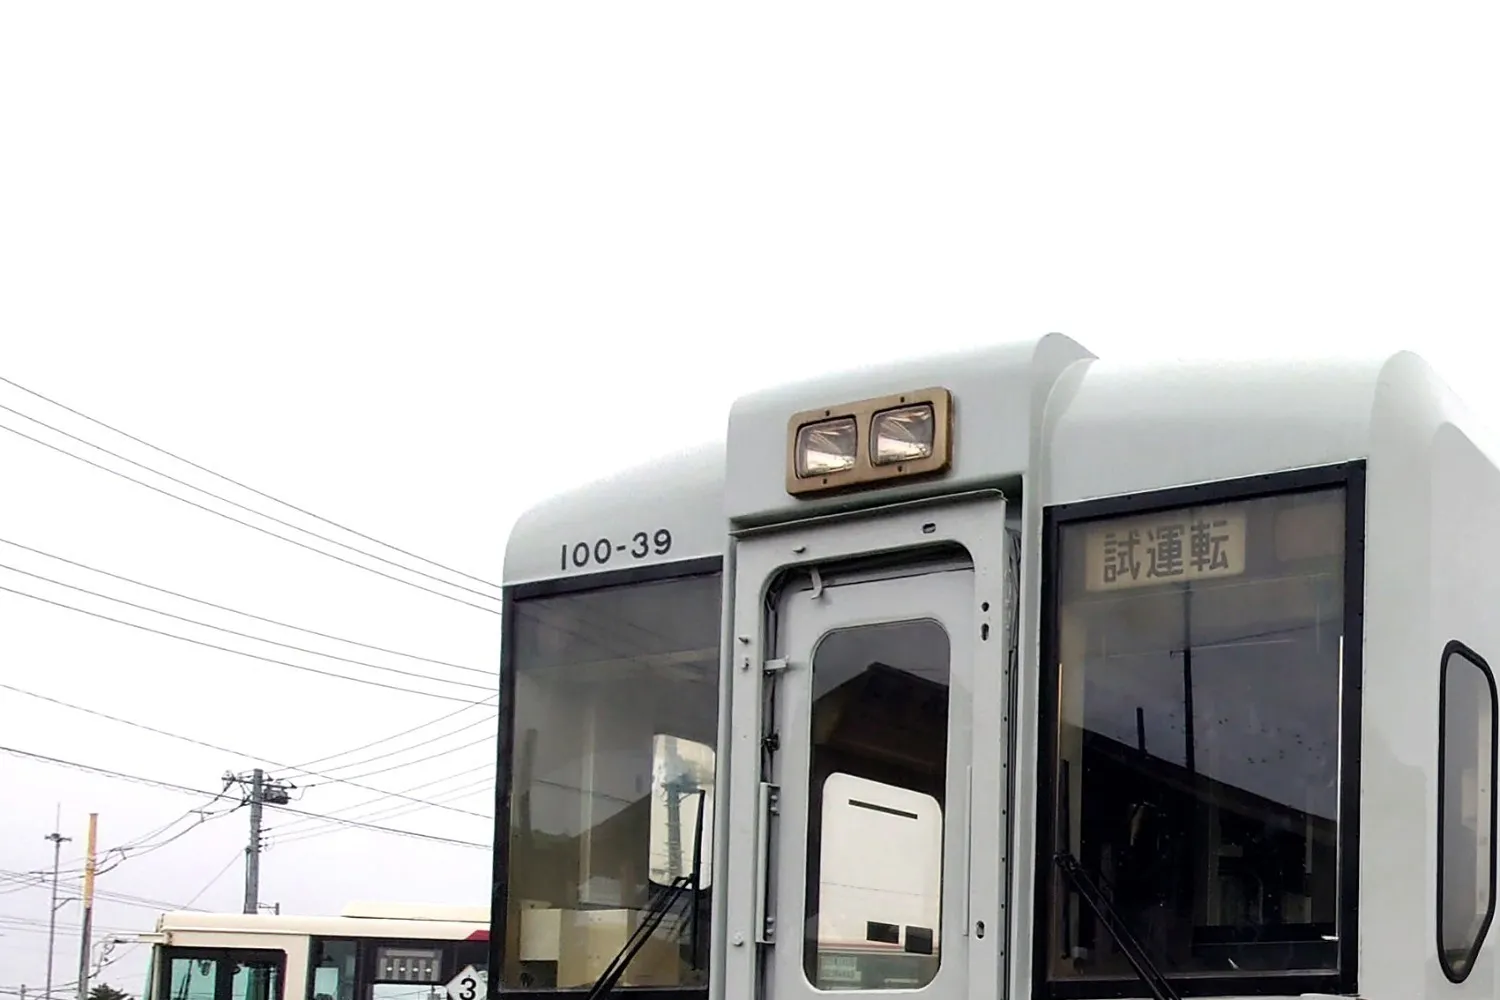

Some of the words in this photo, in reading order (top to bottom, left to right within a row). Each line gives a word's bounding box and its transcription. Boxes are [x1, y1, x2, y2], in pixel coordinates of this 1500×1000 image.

[560, 528, 672, 571] 100-39
[1103, 520, 1230, 583] 試運転
[459, 978, 477, 1000] 3
